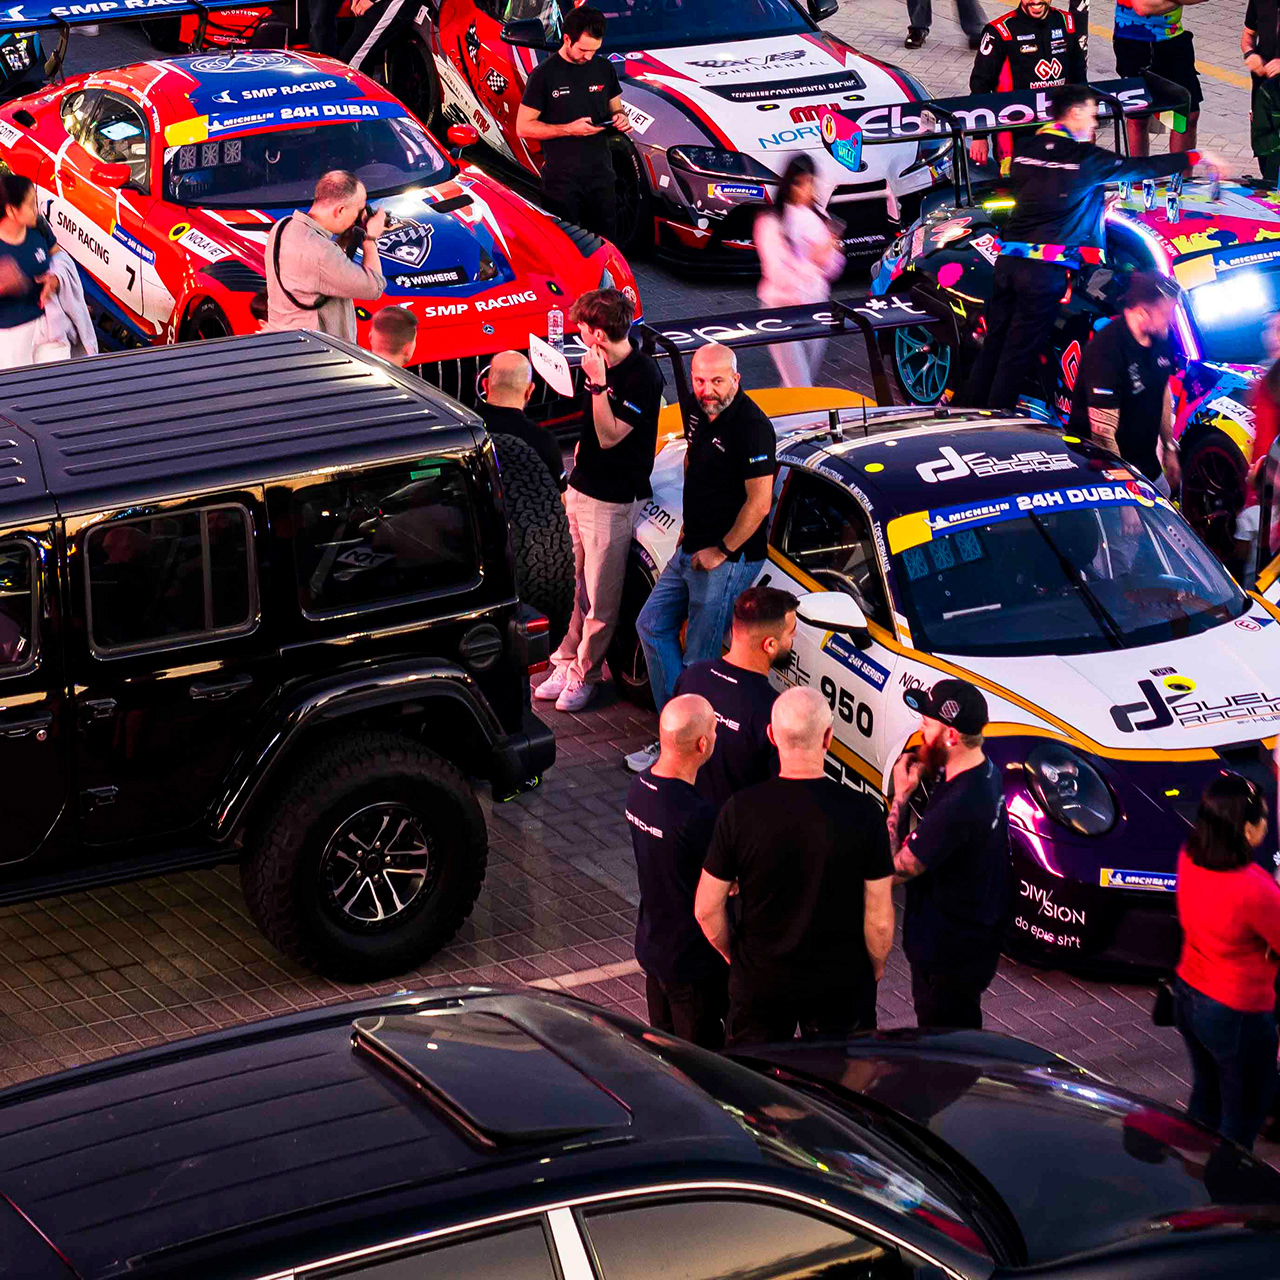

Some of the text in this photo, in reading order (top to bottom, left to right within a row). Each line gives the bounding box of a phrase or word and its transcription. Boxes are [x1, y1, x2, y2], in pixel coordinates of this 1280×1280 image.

[51, 0, 119, 18] SMP
[705, 61, 831, 79] CONTINENTAL
[240, 79, 336, 100] SMP RACING
[769, 83, 827, 97] CONTINENTAL
[828, 79, 859, 91] RACING
[222, 103, 378, 126] MICHELIN 24H DUBAI
[723, 187, 758, 195] MICHELIN
[56, 211, 110, 267] SMP RACING
[1230, 250, 1280, 266] MICHELIN
[124, 265, 136, 292] 7
[411, 271, 459, 286] WINHERE
[424, 290, 538, 318] SMP RACING
[948, 483, 1135, 523] MICHELIN 24H DUBAI
[848, 652, 862, 668] 24H
[860, 659, 885, 686] SERIES
[820, 674, 874, 739] 950
[1124, 875, 1177, 887] MICHELIN
[1014, 913, 1030, 930] do
